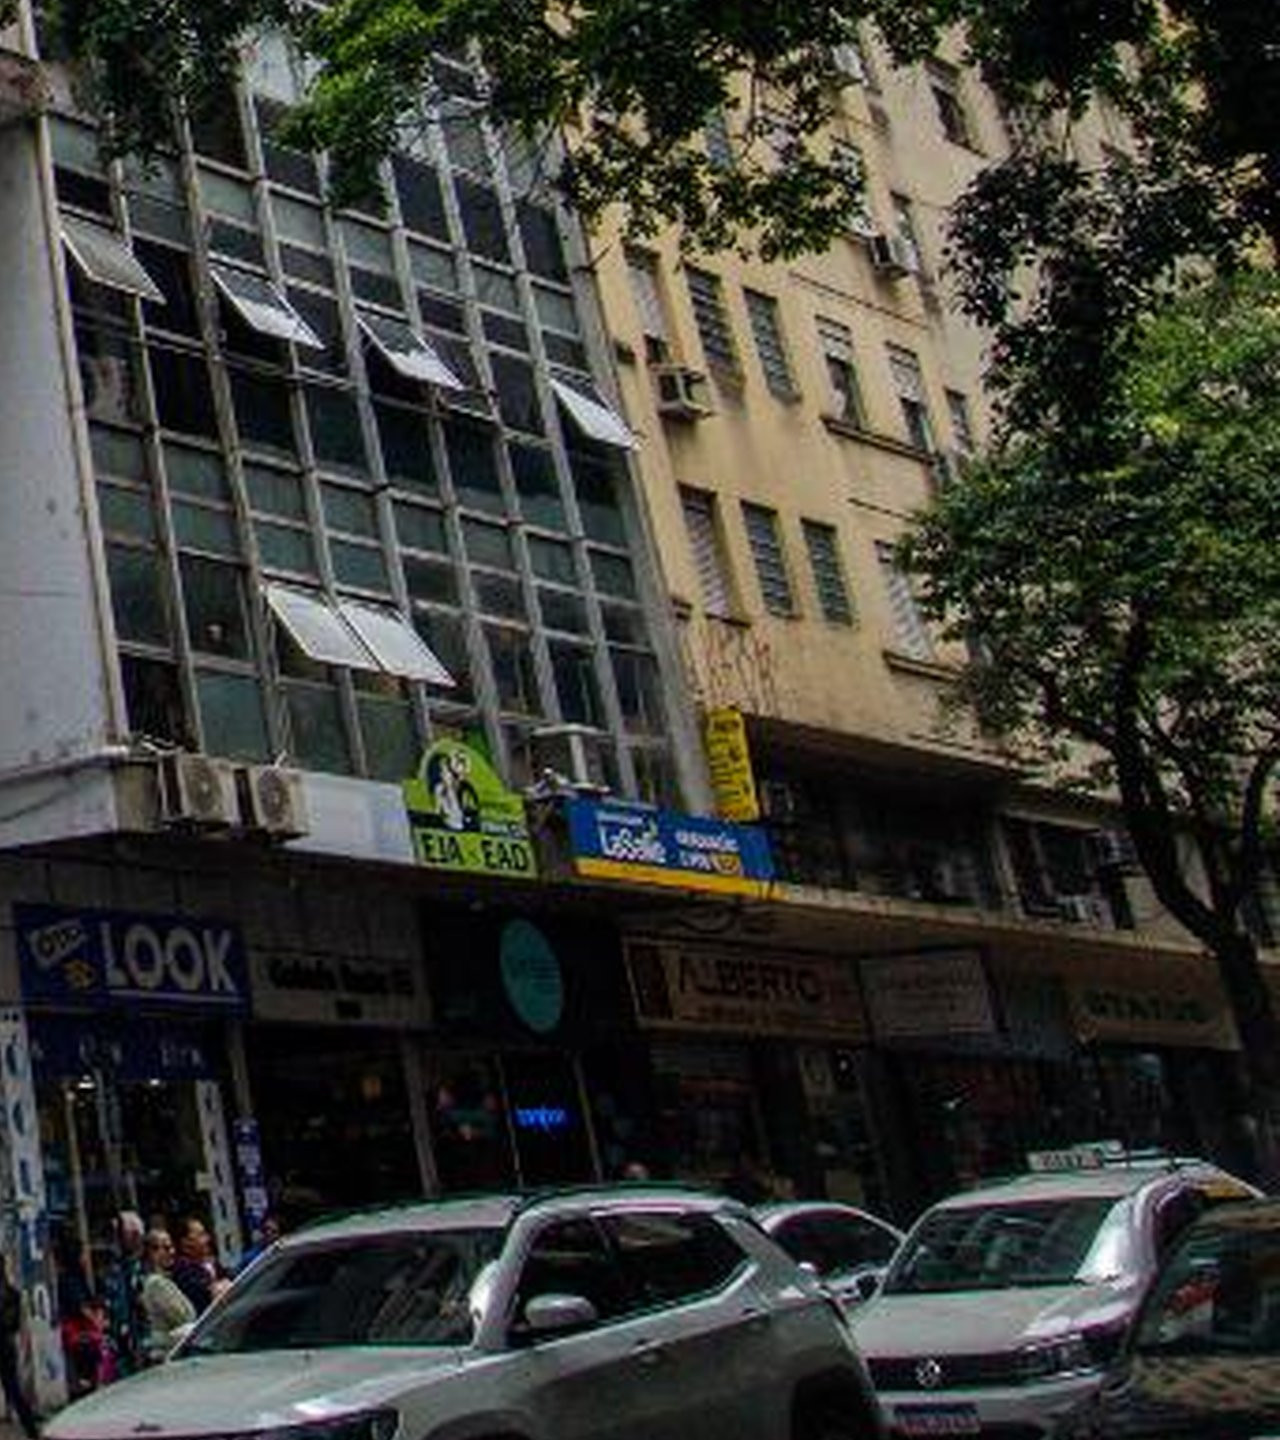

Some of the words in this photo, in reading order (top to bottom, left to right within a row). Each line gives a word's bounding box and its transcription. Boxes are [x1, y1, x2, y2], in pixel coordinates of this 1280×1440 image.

[480, 839, 530, 872] EAD
[101, 917, 238, 994] LOOK
[679, 956, 822, 1002] ALBERTO
